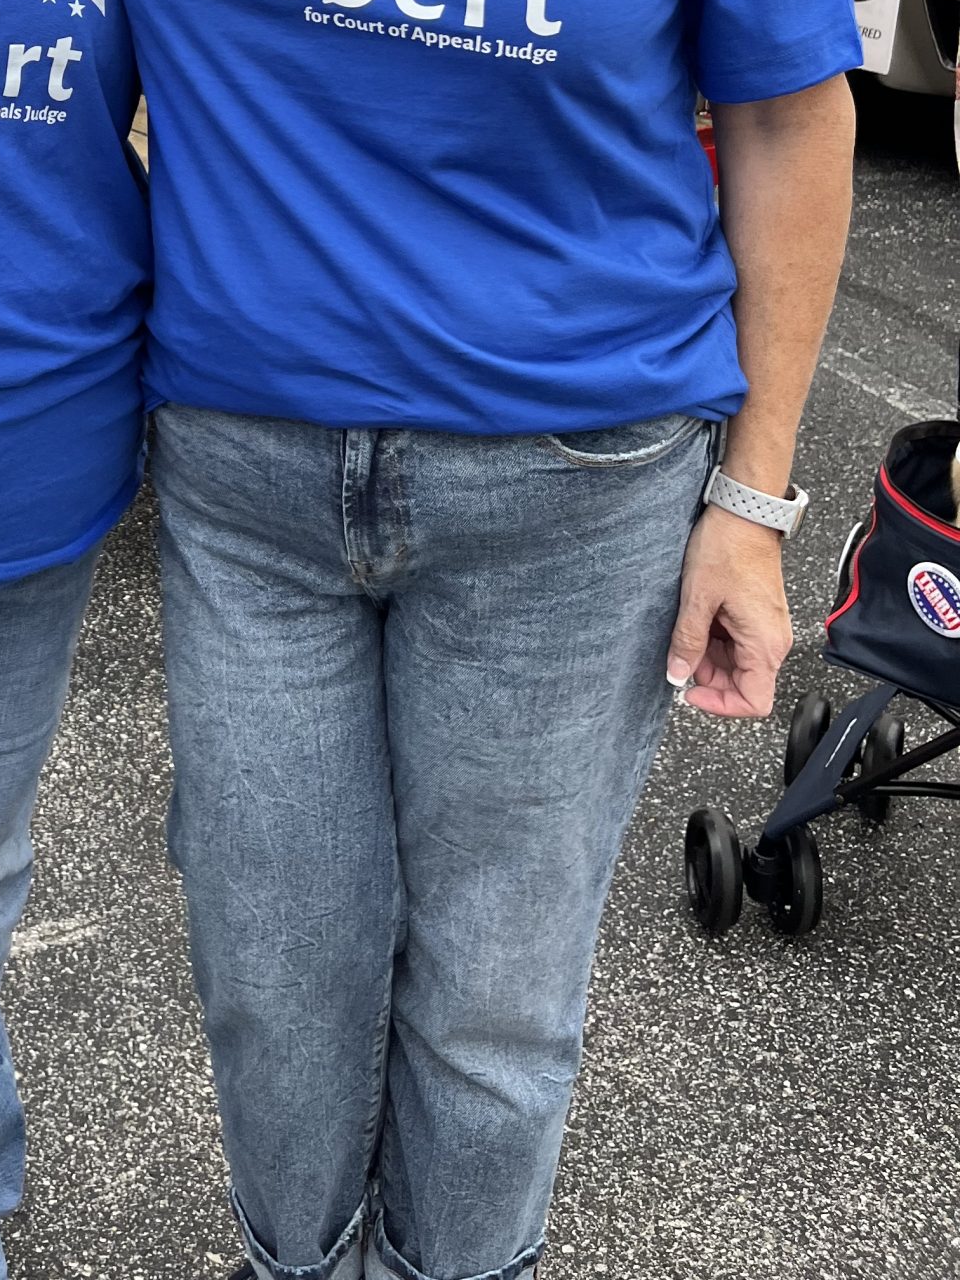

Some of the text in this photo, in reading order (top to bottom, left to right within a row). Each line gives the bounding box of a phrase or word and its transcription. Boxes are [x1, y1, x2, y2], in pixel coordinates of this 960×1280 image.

[303, 6, 558, 65] for Court of Appeals Judge
[23, 105, 67, 125] Judge
